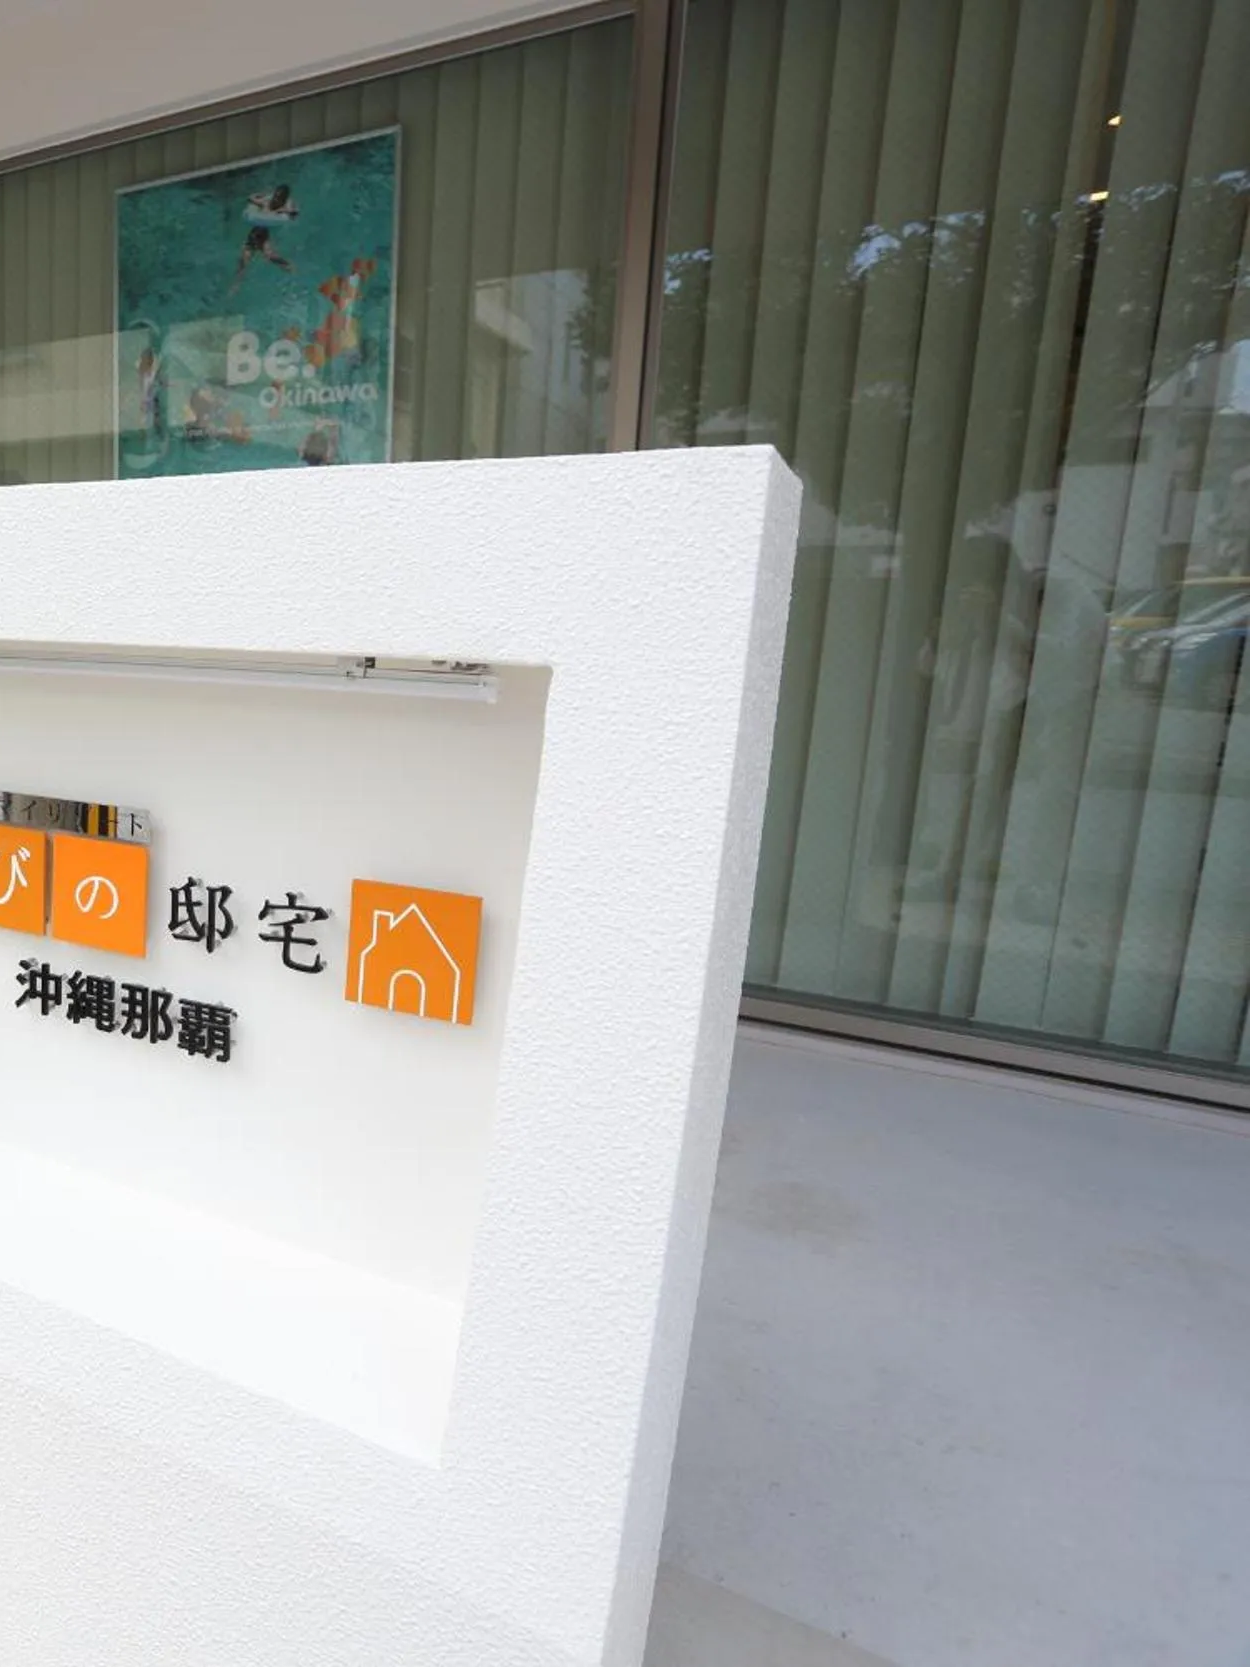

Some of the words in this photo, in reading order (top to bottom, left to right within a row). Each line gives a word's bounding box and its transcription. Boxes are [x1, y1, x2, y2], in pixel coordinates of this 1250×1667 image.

[258, 381, 378, 409] Okinawa
[16, 958, 238, 1063] 沖縄那覇
